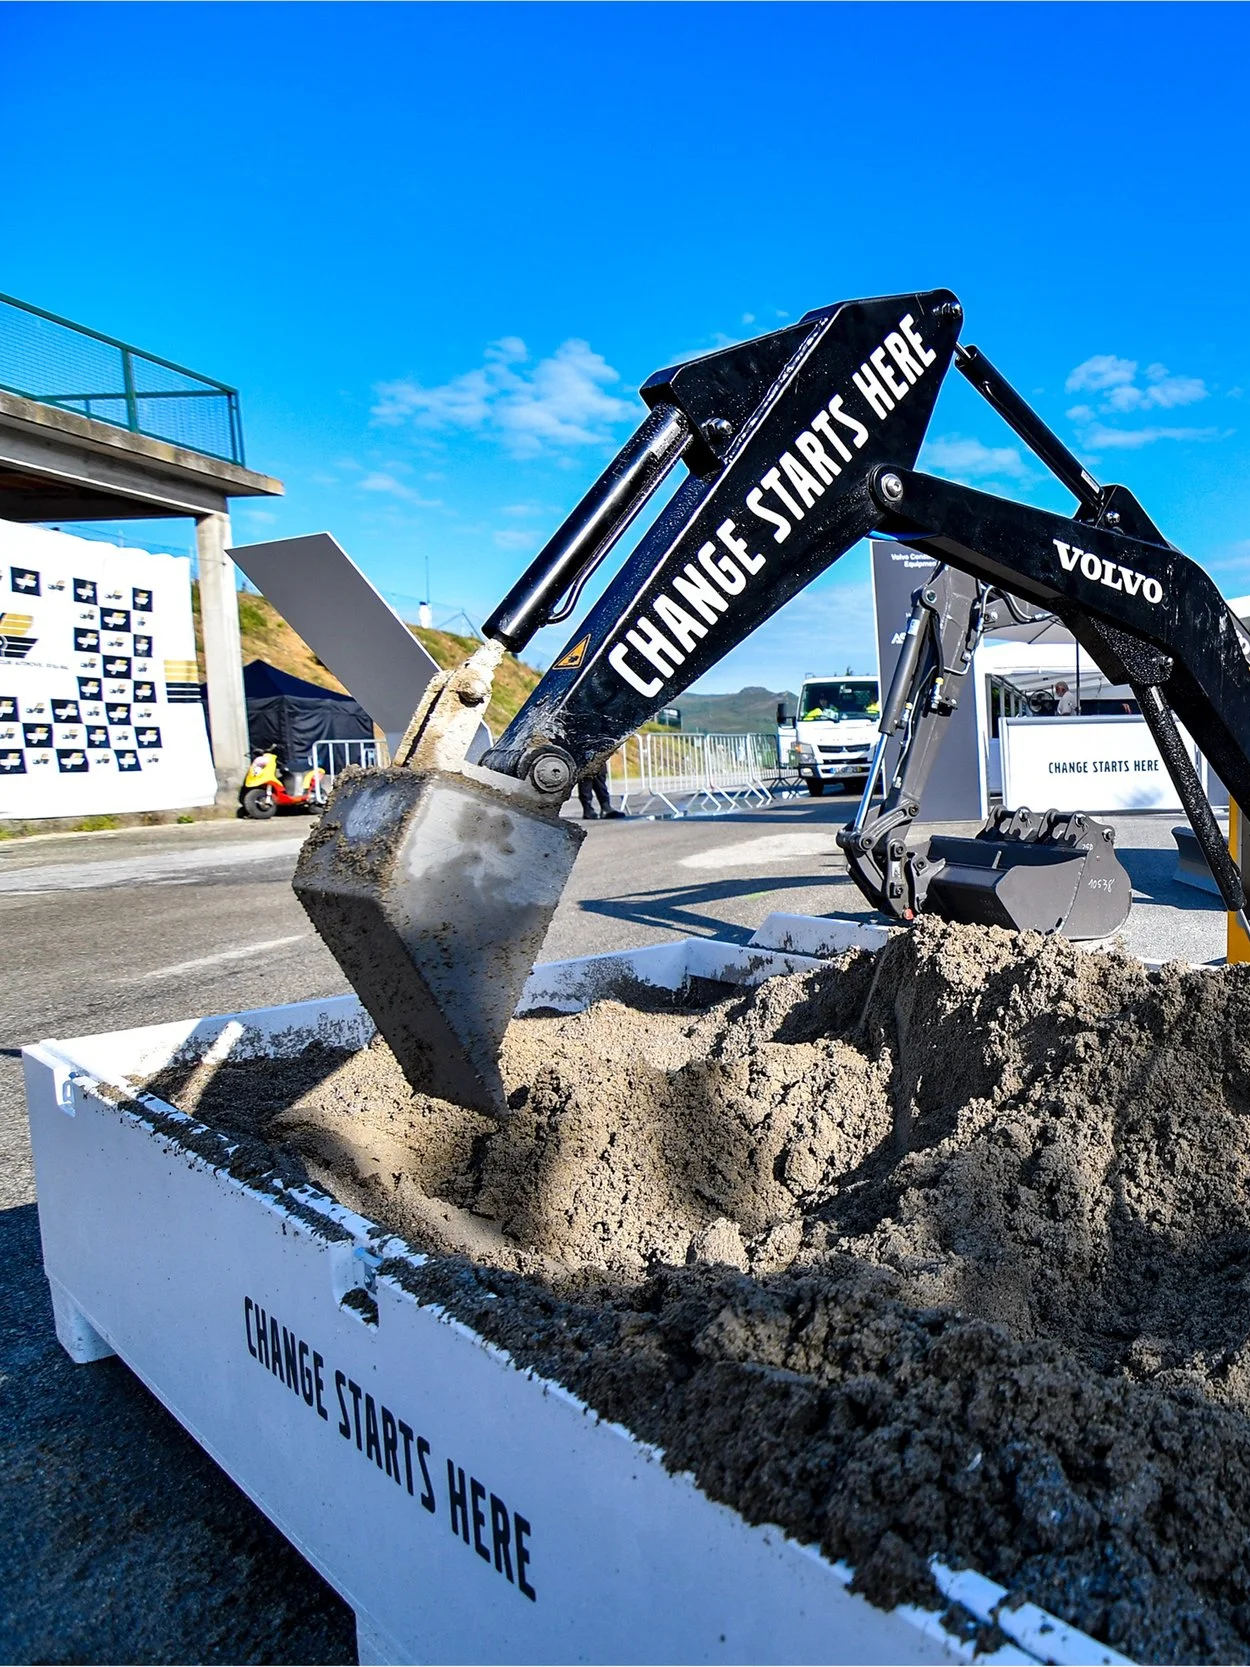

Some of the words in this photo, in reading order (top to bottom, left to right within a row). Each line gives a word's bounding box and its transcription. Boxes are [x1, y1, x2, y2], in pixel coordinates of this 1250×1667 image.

[608, 518, 766, 698] CHANGE
[745, 394, 870, 544] STARTS
[852, 314, 937, 421] HERE
[1052, 538, 1164, 604] VOLVO
[1048, 761, 1089, 774] CHANGE
[1093, 760, 1130, 773] STARTS
[1134, 759, 1159, 772] HERE
[244, 1295, 329, 1421] CHANGE
[335, 1369, 436, 1514] STARTS
[447, 1458, 537, 1602] HERE
